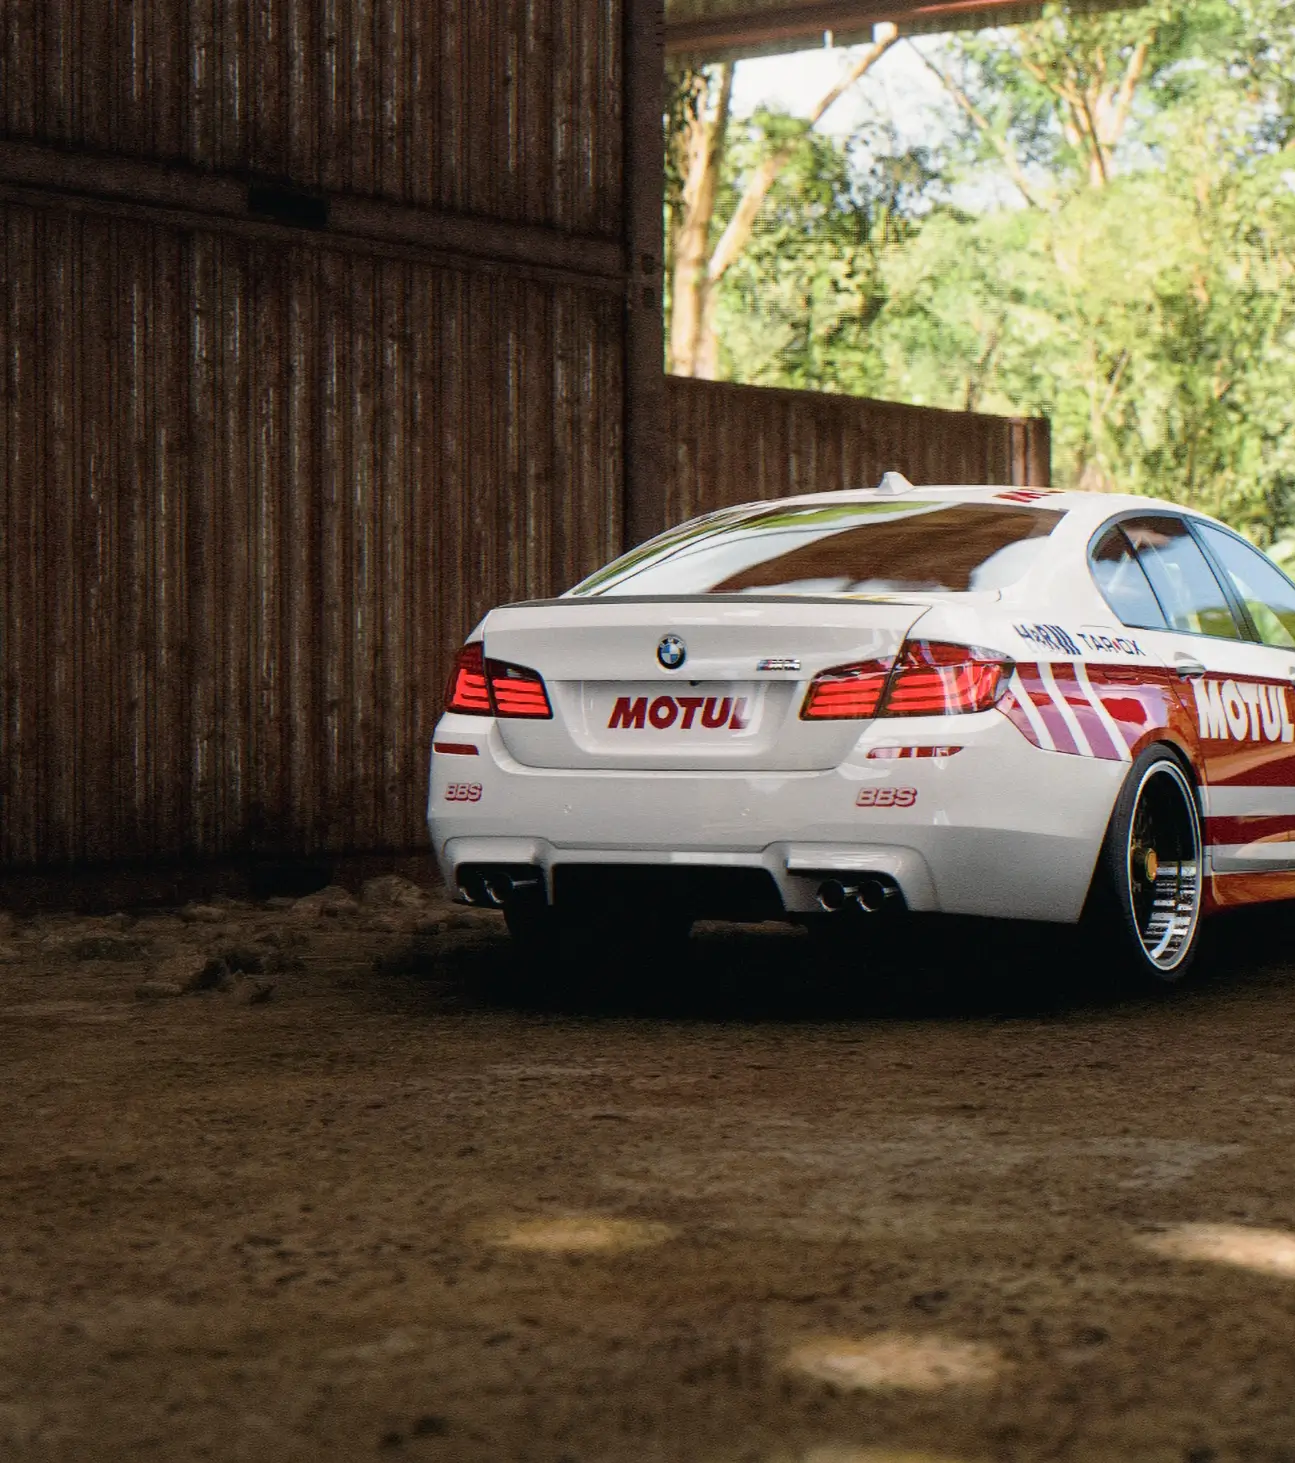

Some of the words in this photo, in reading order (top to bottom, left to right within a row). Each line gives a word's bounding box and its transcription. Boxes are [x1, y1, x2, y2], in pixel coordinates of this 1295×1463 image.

[607, 695, 749, 730] MOTUL
[1190, 679, 1294, 743] MOTUL
[445, 782, 482, 802] BBS
[856, 787, 917, 807] BBS
